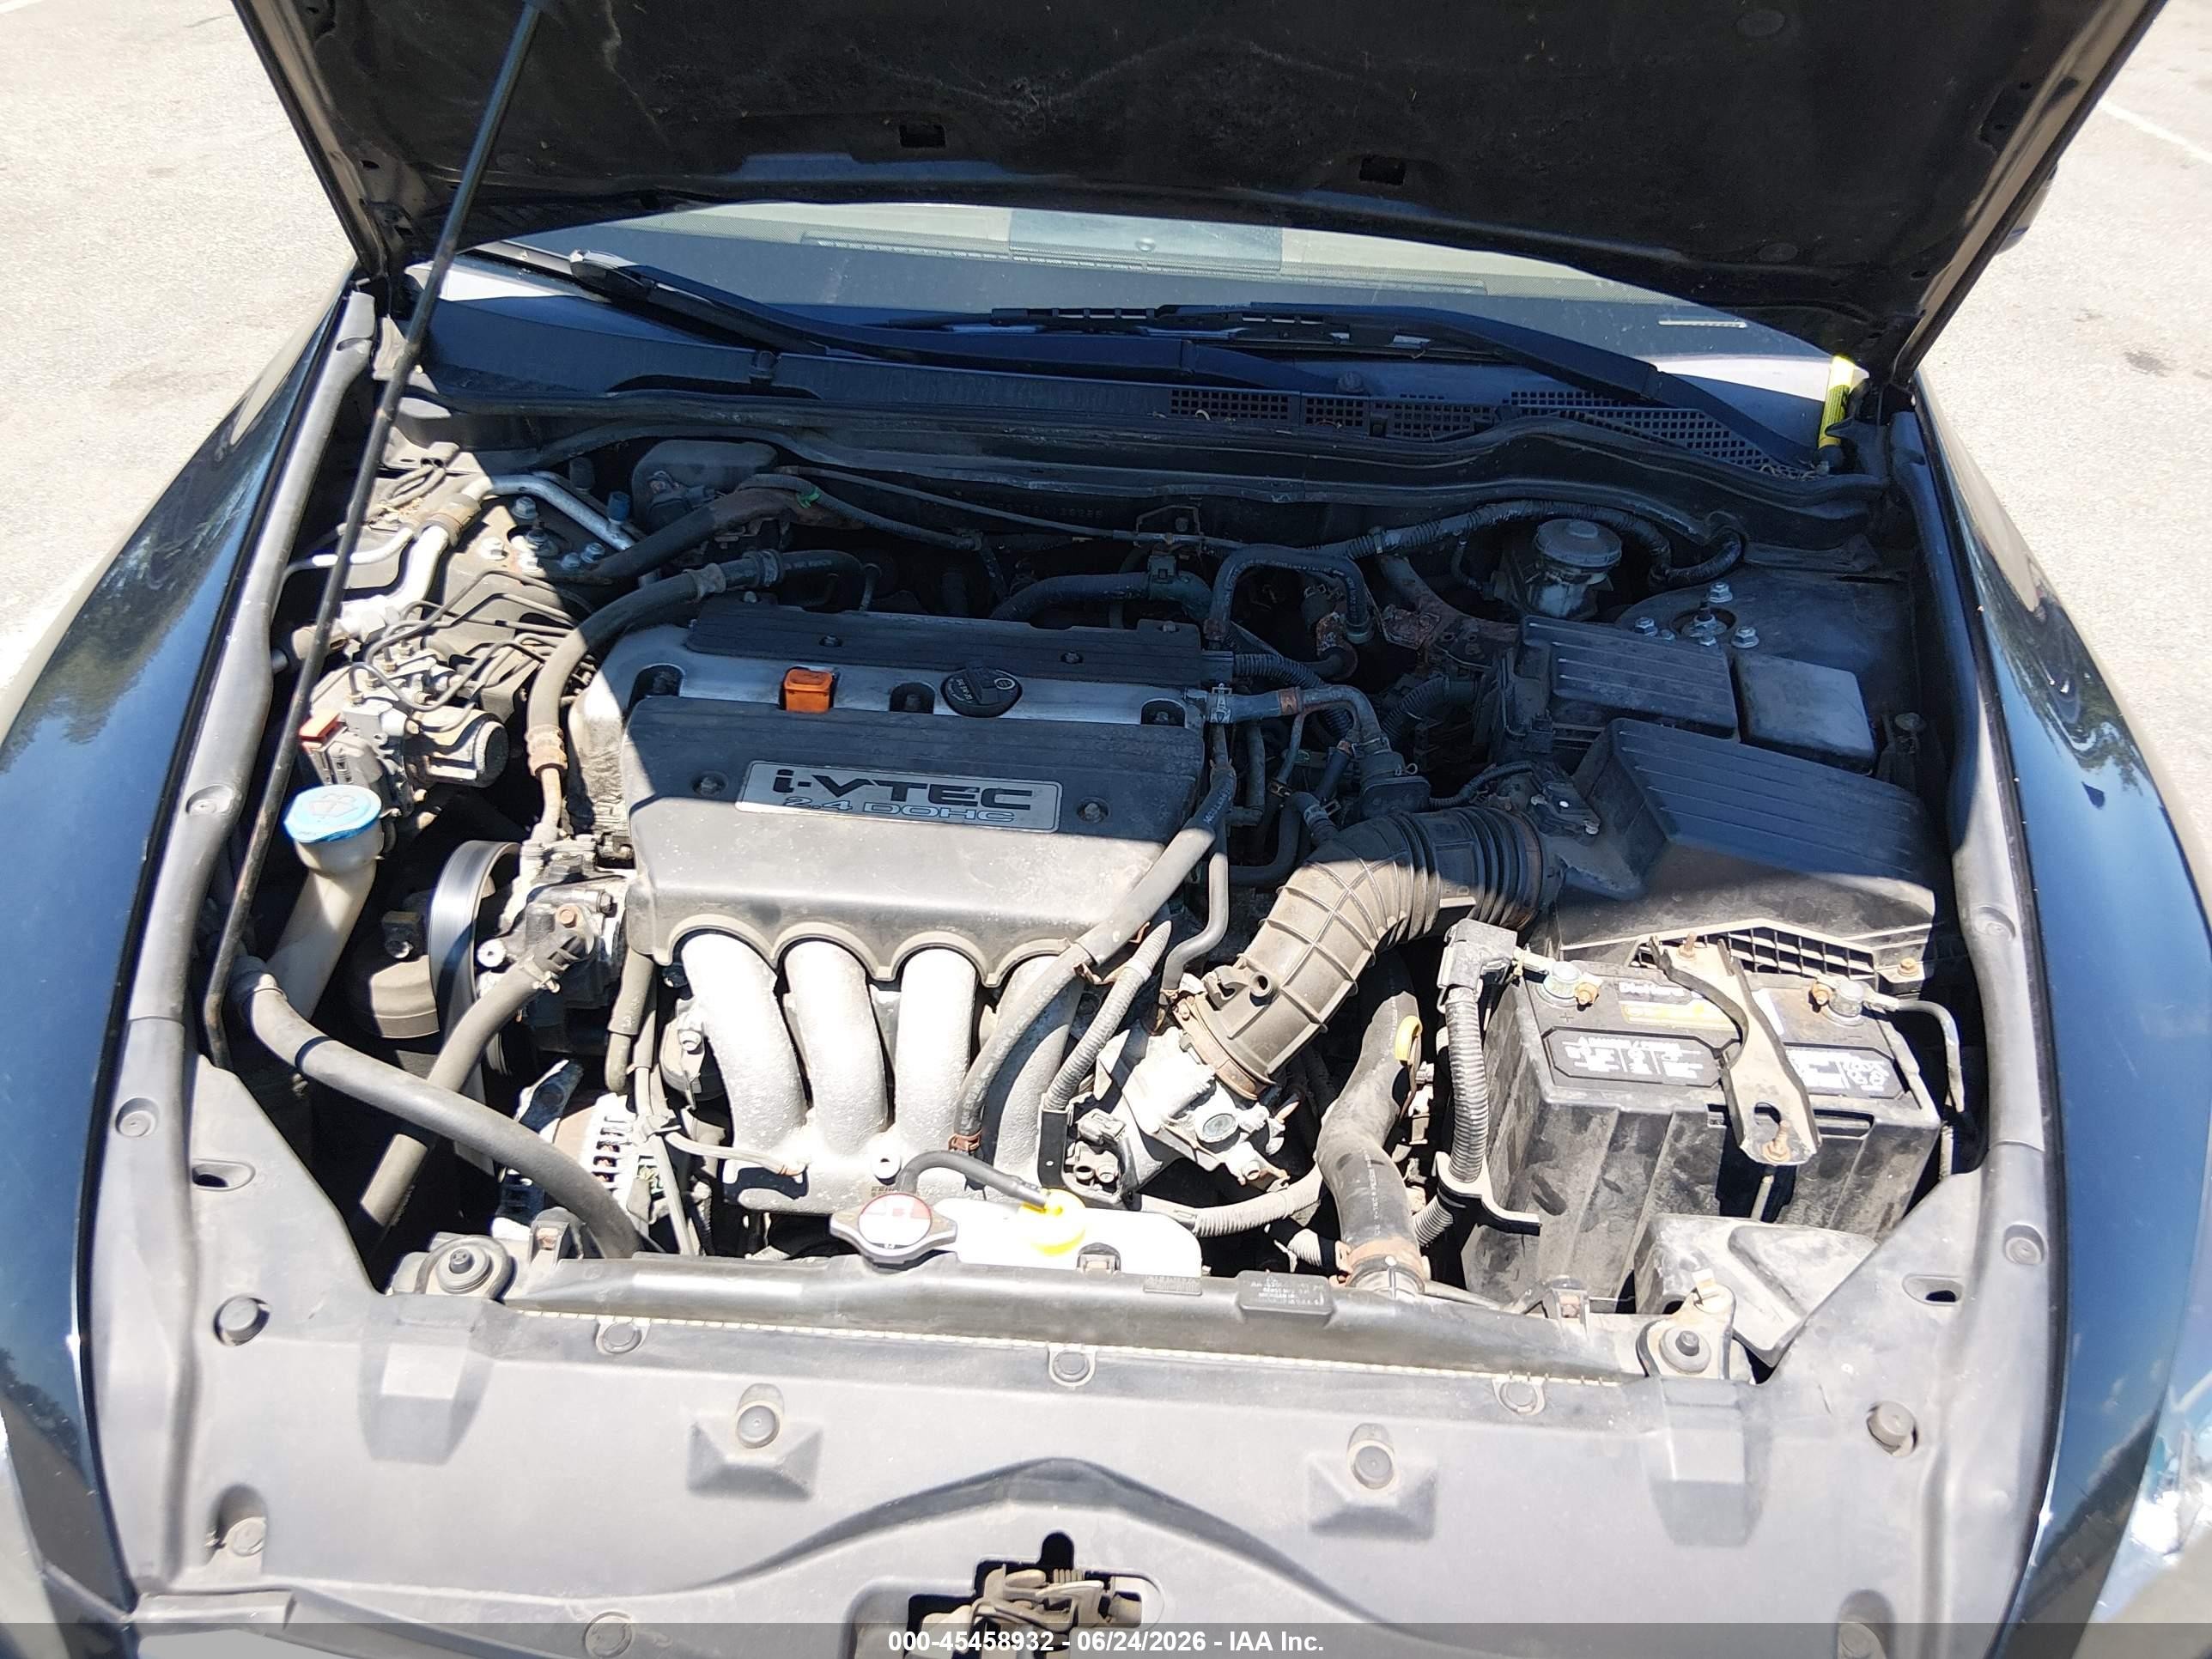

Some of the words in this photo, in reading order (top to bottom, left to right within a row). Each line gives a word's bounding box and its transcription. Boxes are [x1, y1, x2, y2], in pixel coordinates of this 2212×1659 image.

[774, 769, 1033, 811] i-VTEC
[783, 796, 854, 811] 2.4
[863, 802, 1016, 823] DOHC
